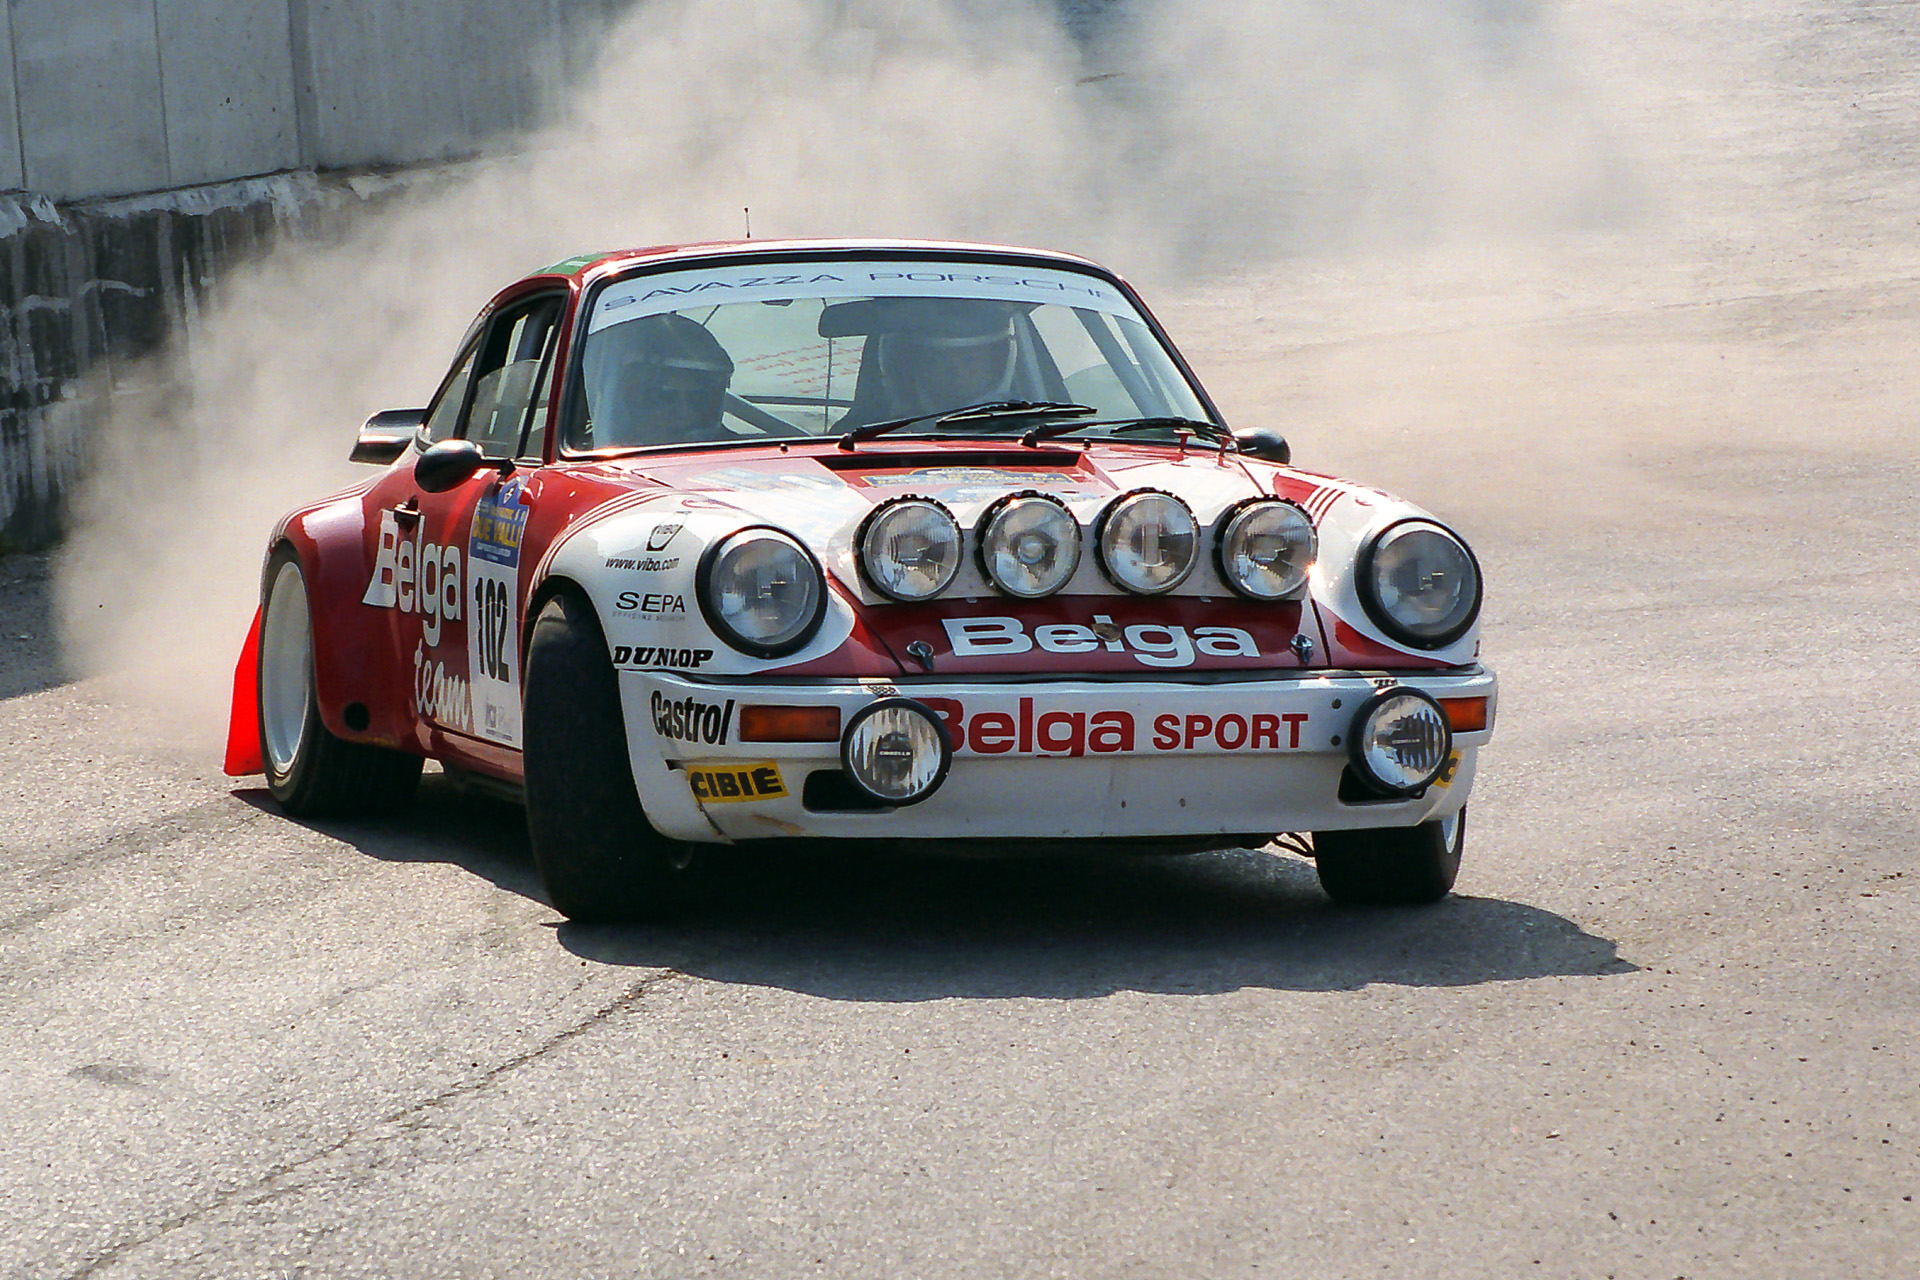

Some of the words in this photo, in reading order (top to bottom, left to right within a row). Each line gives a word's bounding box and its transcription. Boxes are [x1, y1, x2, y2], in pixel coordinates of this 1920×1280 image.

[604, 274, 844, 311] SAVAZZA
[362, 509, 462, 647] Belga
[605, 556, 680, 572] www.vibo.com
[615, 591, 686, 613] SEPA
[474, 576, 510, 684] 102
[613, 645, 713, 668] DUNLOP
[941, 615, 1260, 667] Belga
[414, 638, 470, 732] team
[650, 690, 735, 746] Castrol
[910, 697, 1135, 757] Belga
[1152, 713, 1309, 750] SPORT
